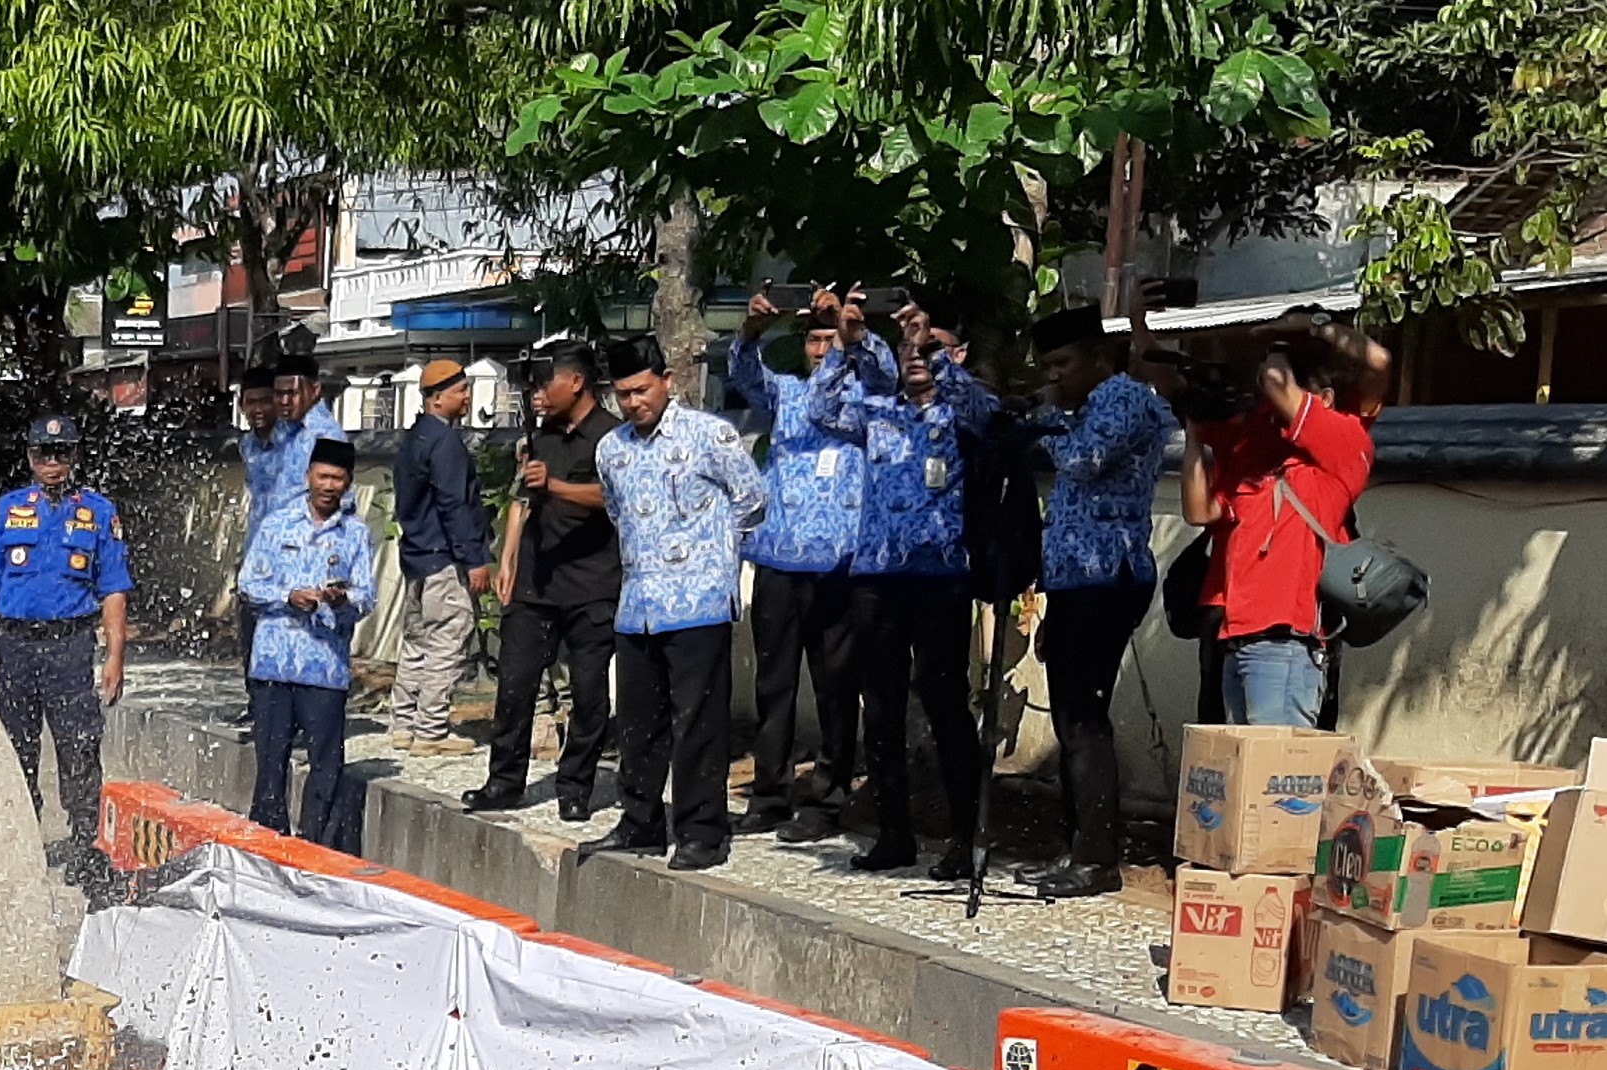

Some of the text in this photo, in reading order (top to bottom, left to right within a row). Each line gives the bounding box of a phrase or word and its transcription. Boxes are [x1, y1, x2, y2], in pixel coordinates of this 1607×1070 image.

[1262, 774, 1326, 797] AQUA
[1451, 836, 1489, 852] ECO
[1335, 841, 1362, 882] Cleo
[1185, 903, 1237, 933] Vit
